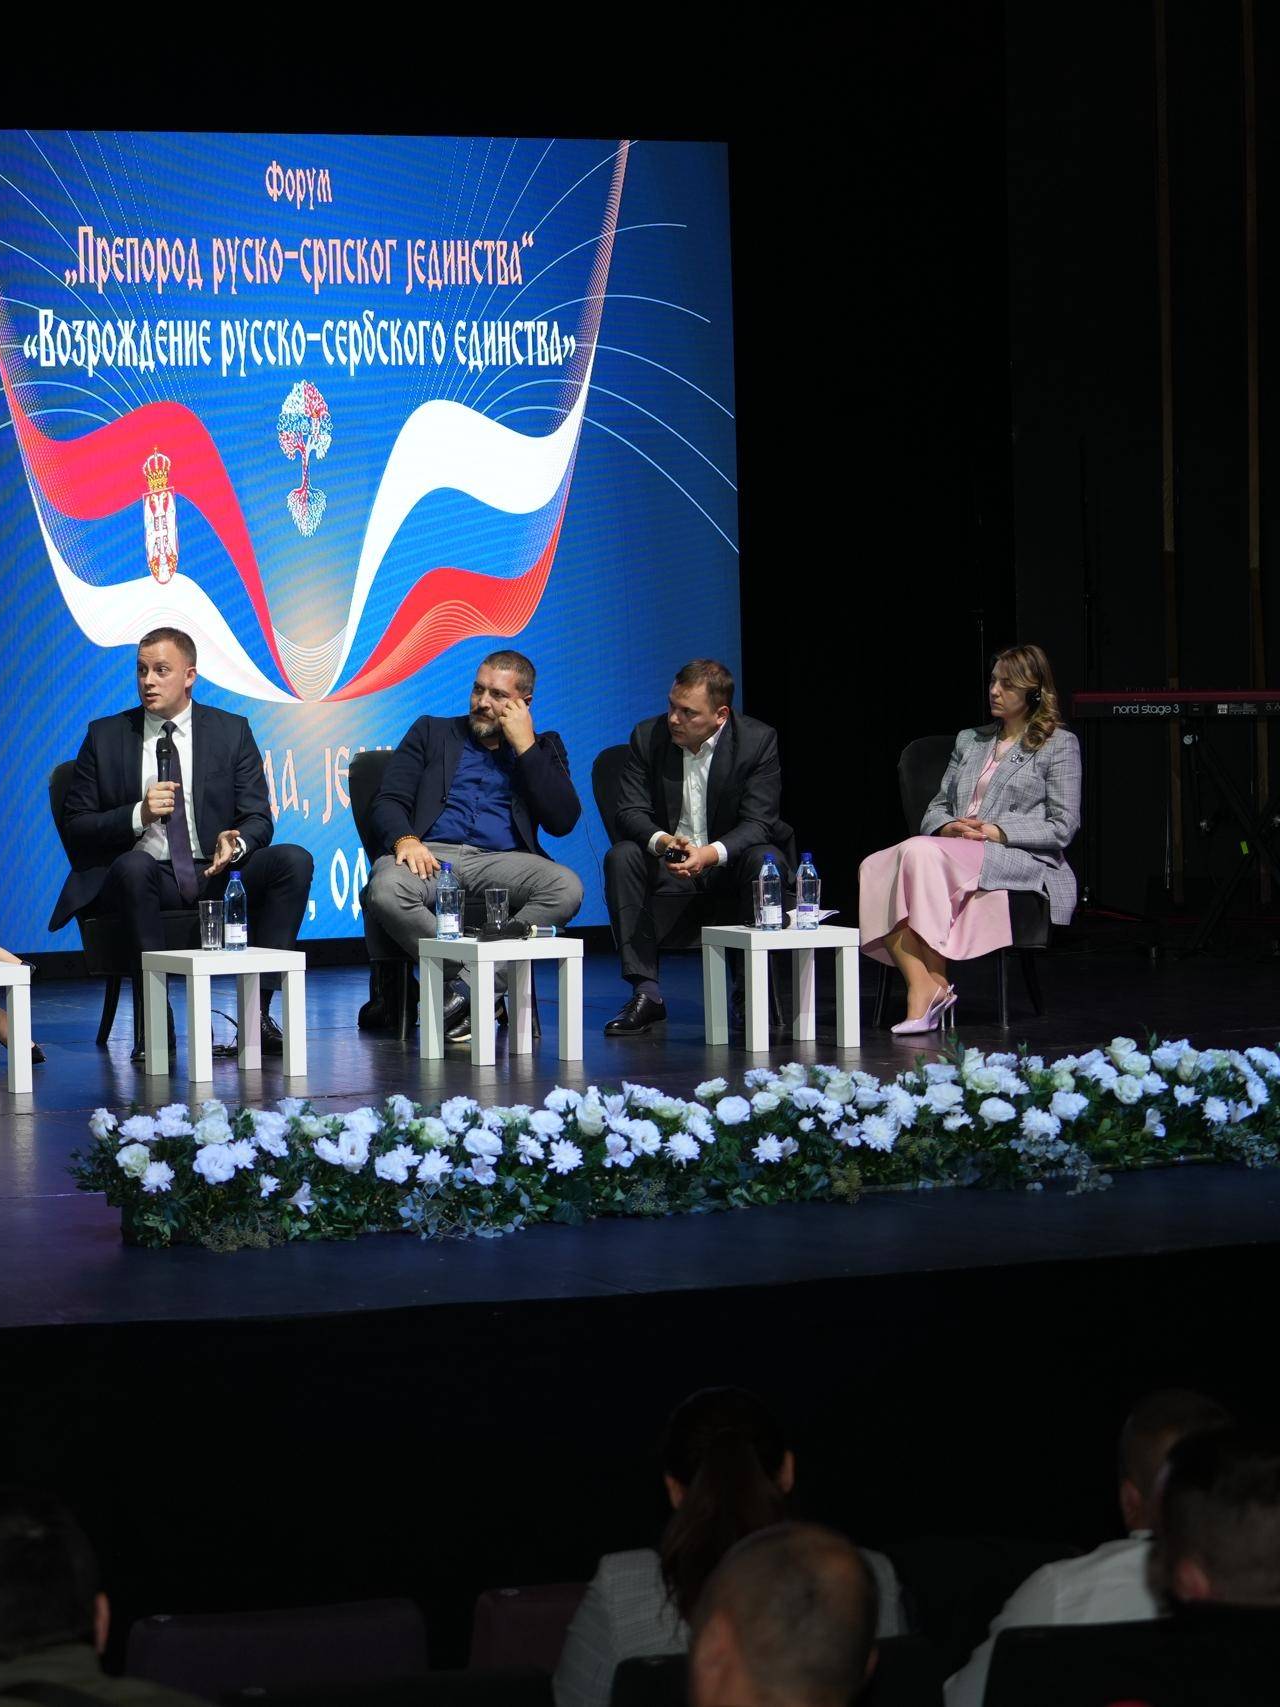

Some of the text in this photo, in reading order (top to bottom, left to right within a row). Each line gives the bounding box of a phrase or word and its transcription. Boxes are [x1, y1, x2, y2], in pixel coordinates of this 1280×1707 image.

[265, 160, 333, 210] Форум
[64, 226, 203, 294] „Препород
[212, 237, 397, 294] руско-српског
[23, 309, 575, 377] «Возрождение русско-сербского единства»
[1113, 703, 1180, 716] nord stage 3
